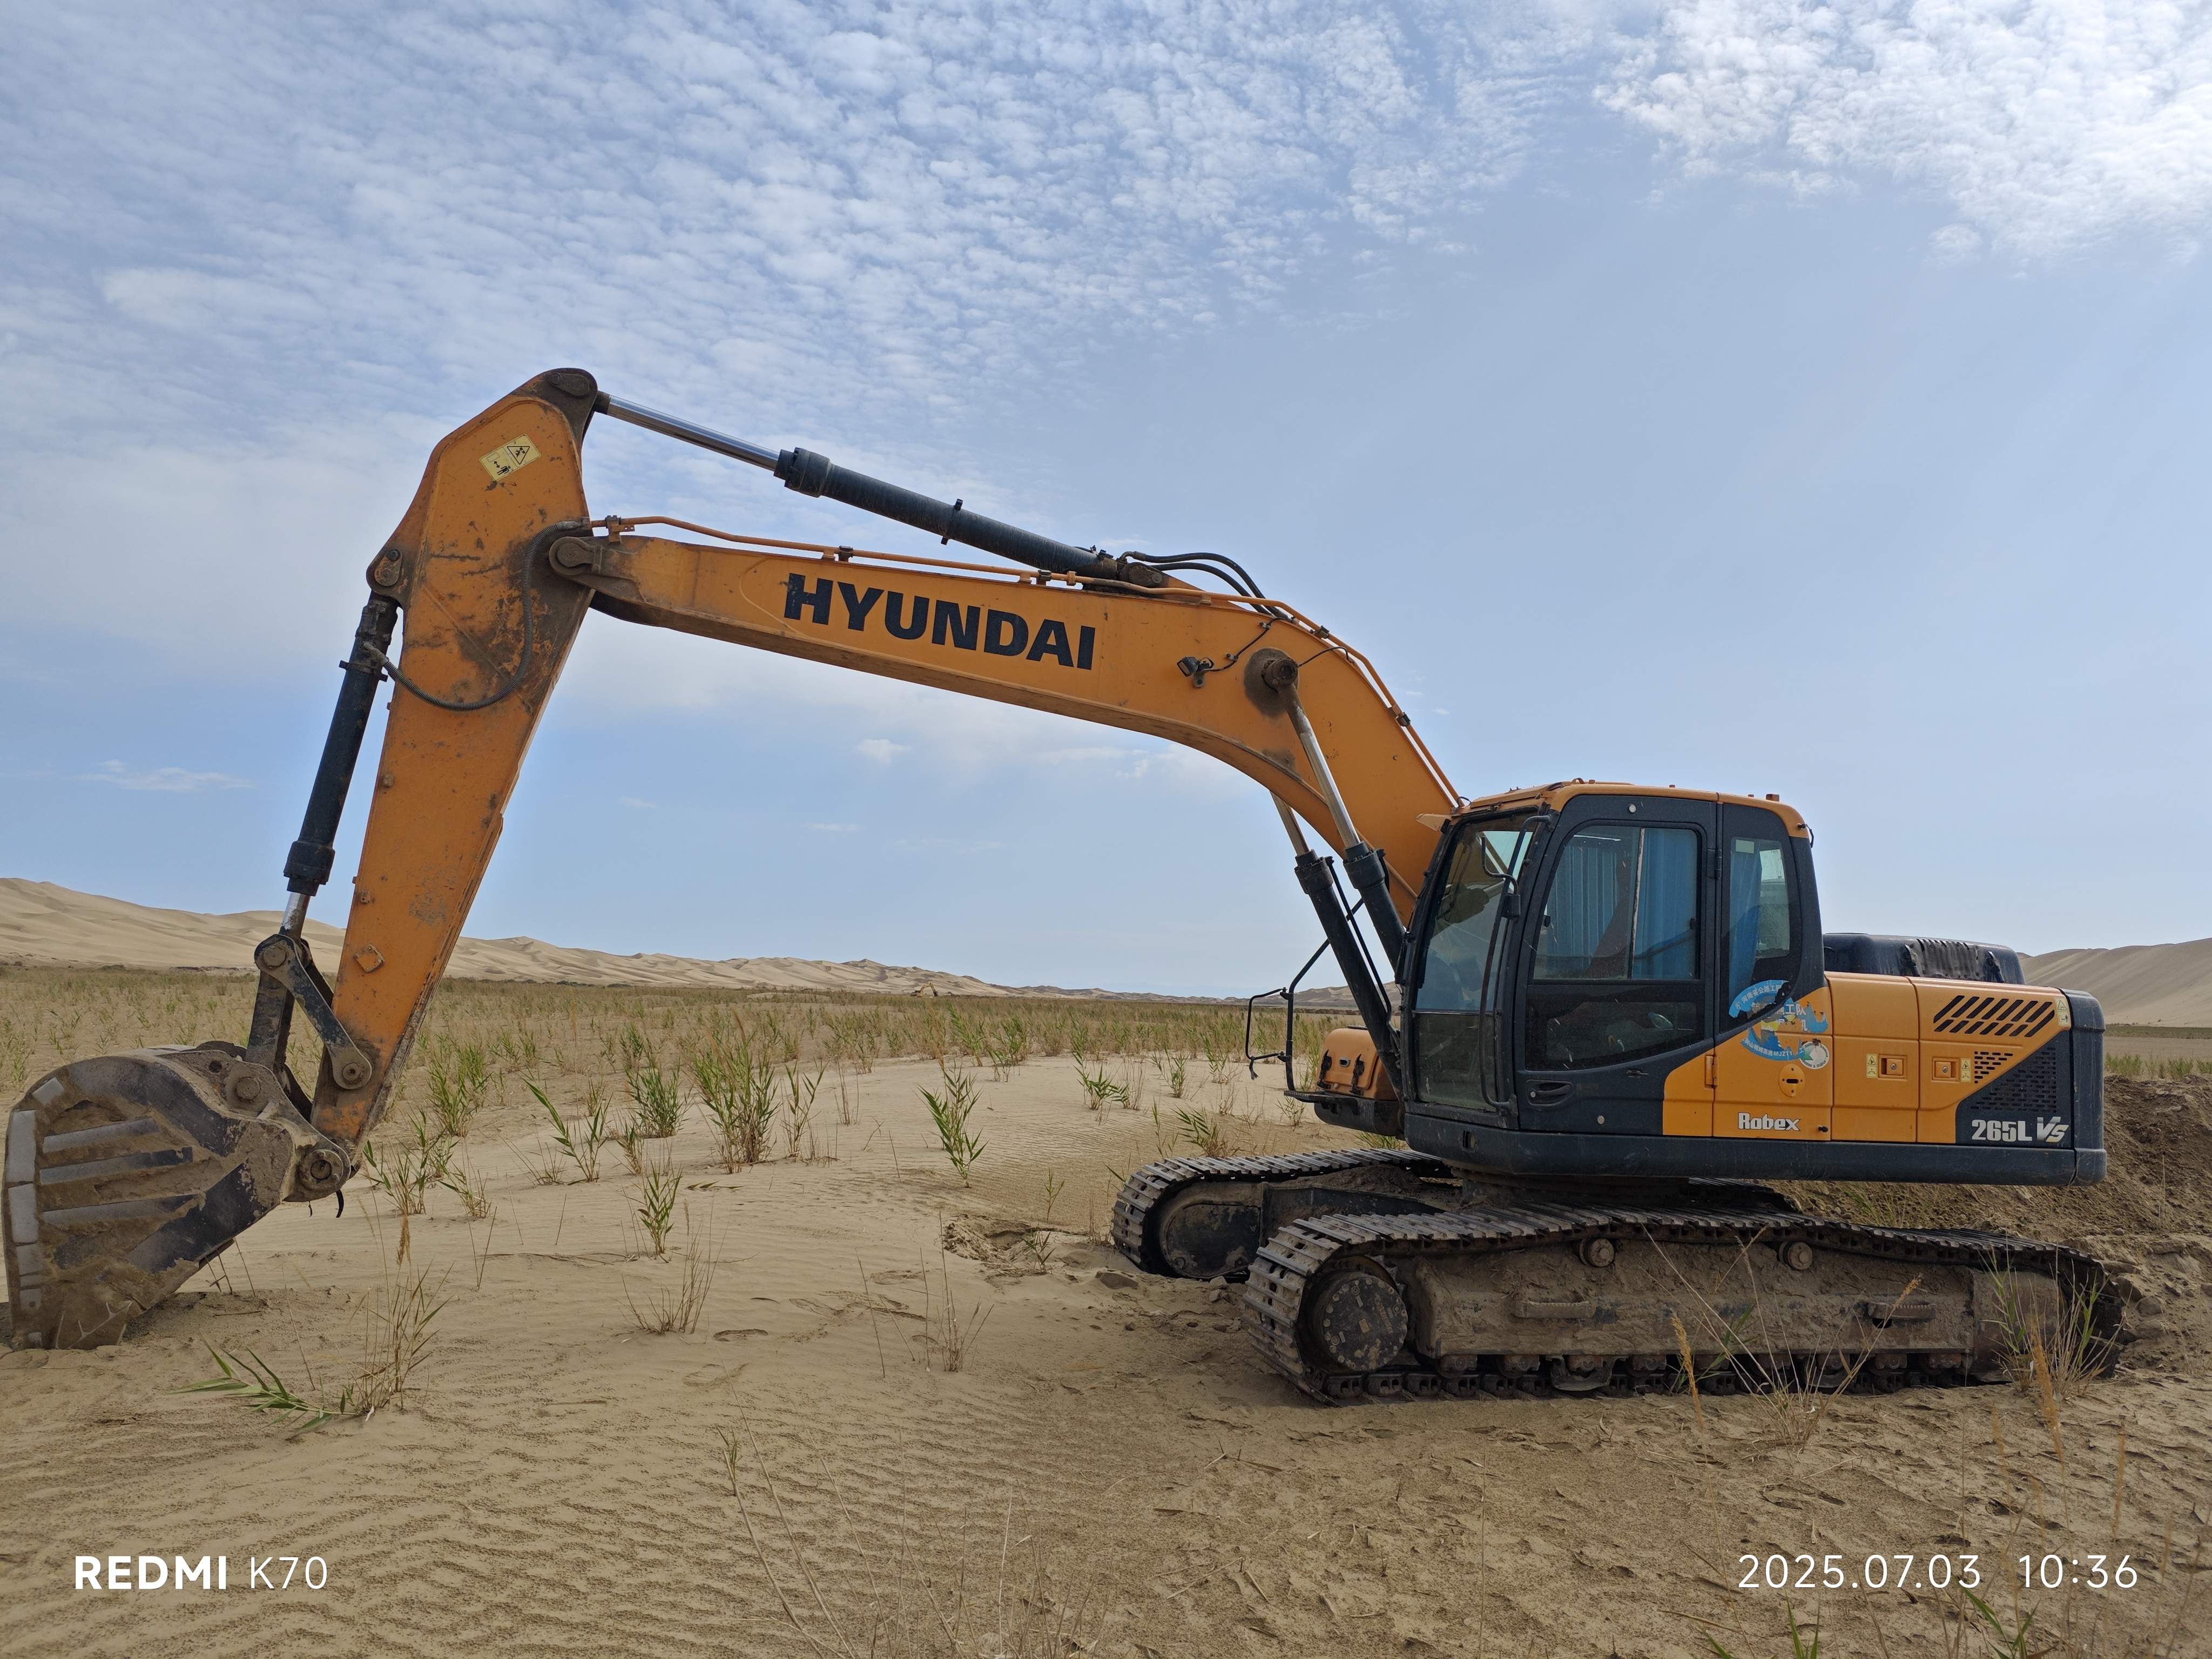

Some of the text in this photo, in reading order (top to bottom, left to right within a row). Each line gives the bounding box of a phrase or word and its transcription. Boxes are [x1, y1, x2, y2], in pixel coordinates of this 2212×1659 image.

[784, 572, 1096, 670] HYUNDAI
[1738, 1112, 1801, 1131] Robex
[1972, 1120, 2032, 1142] 265L
